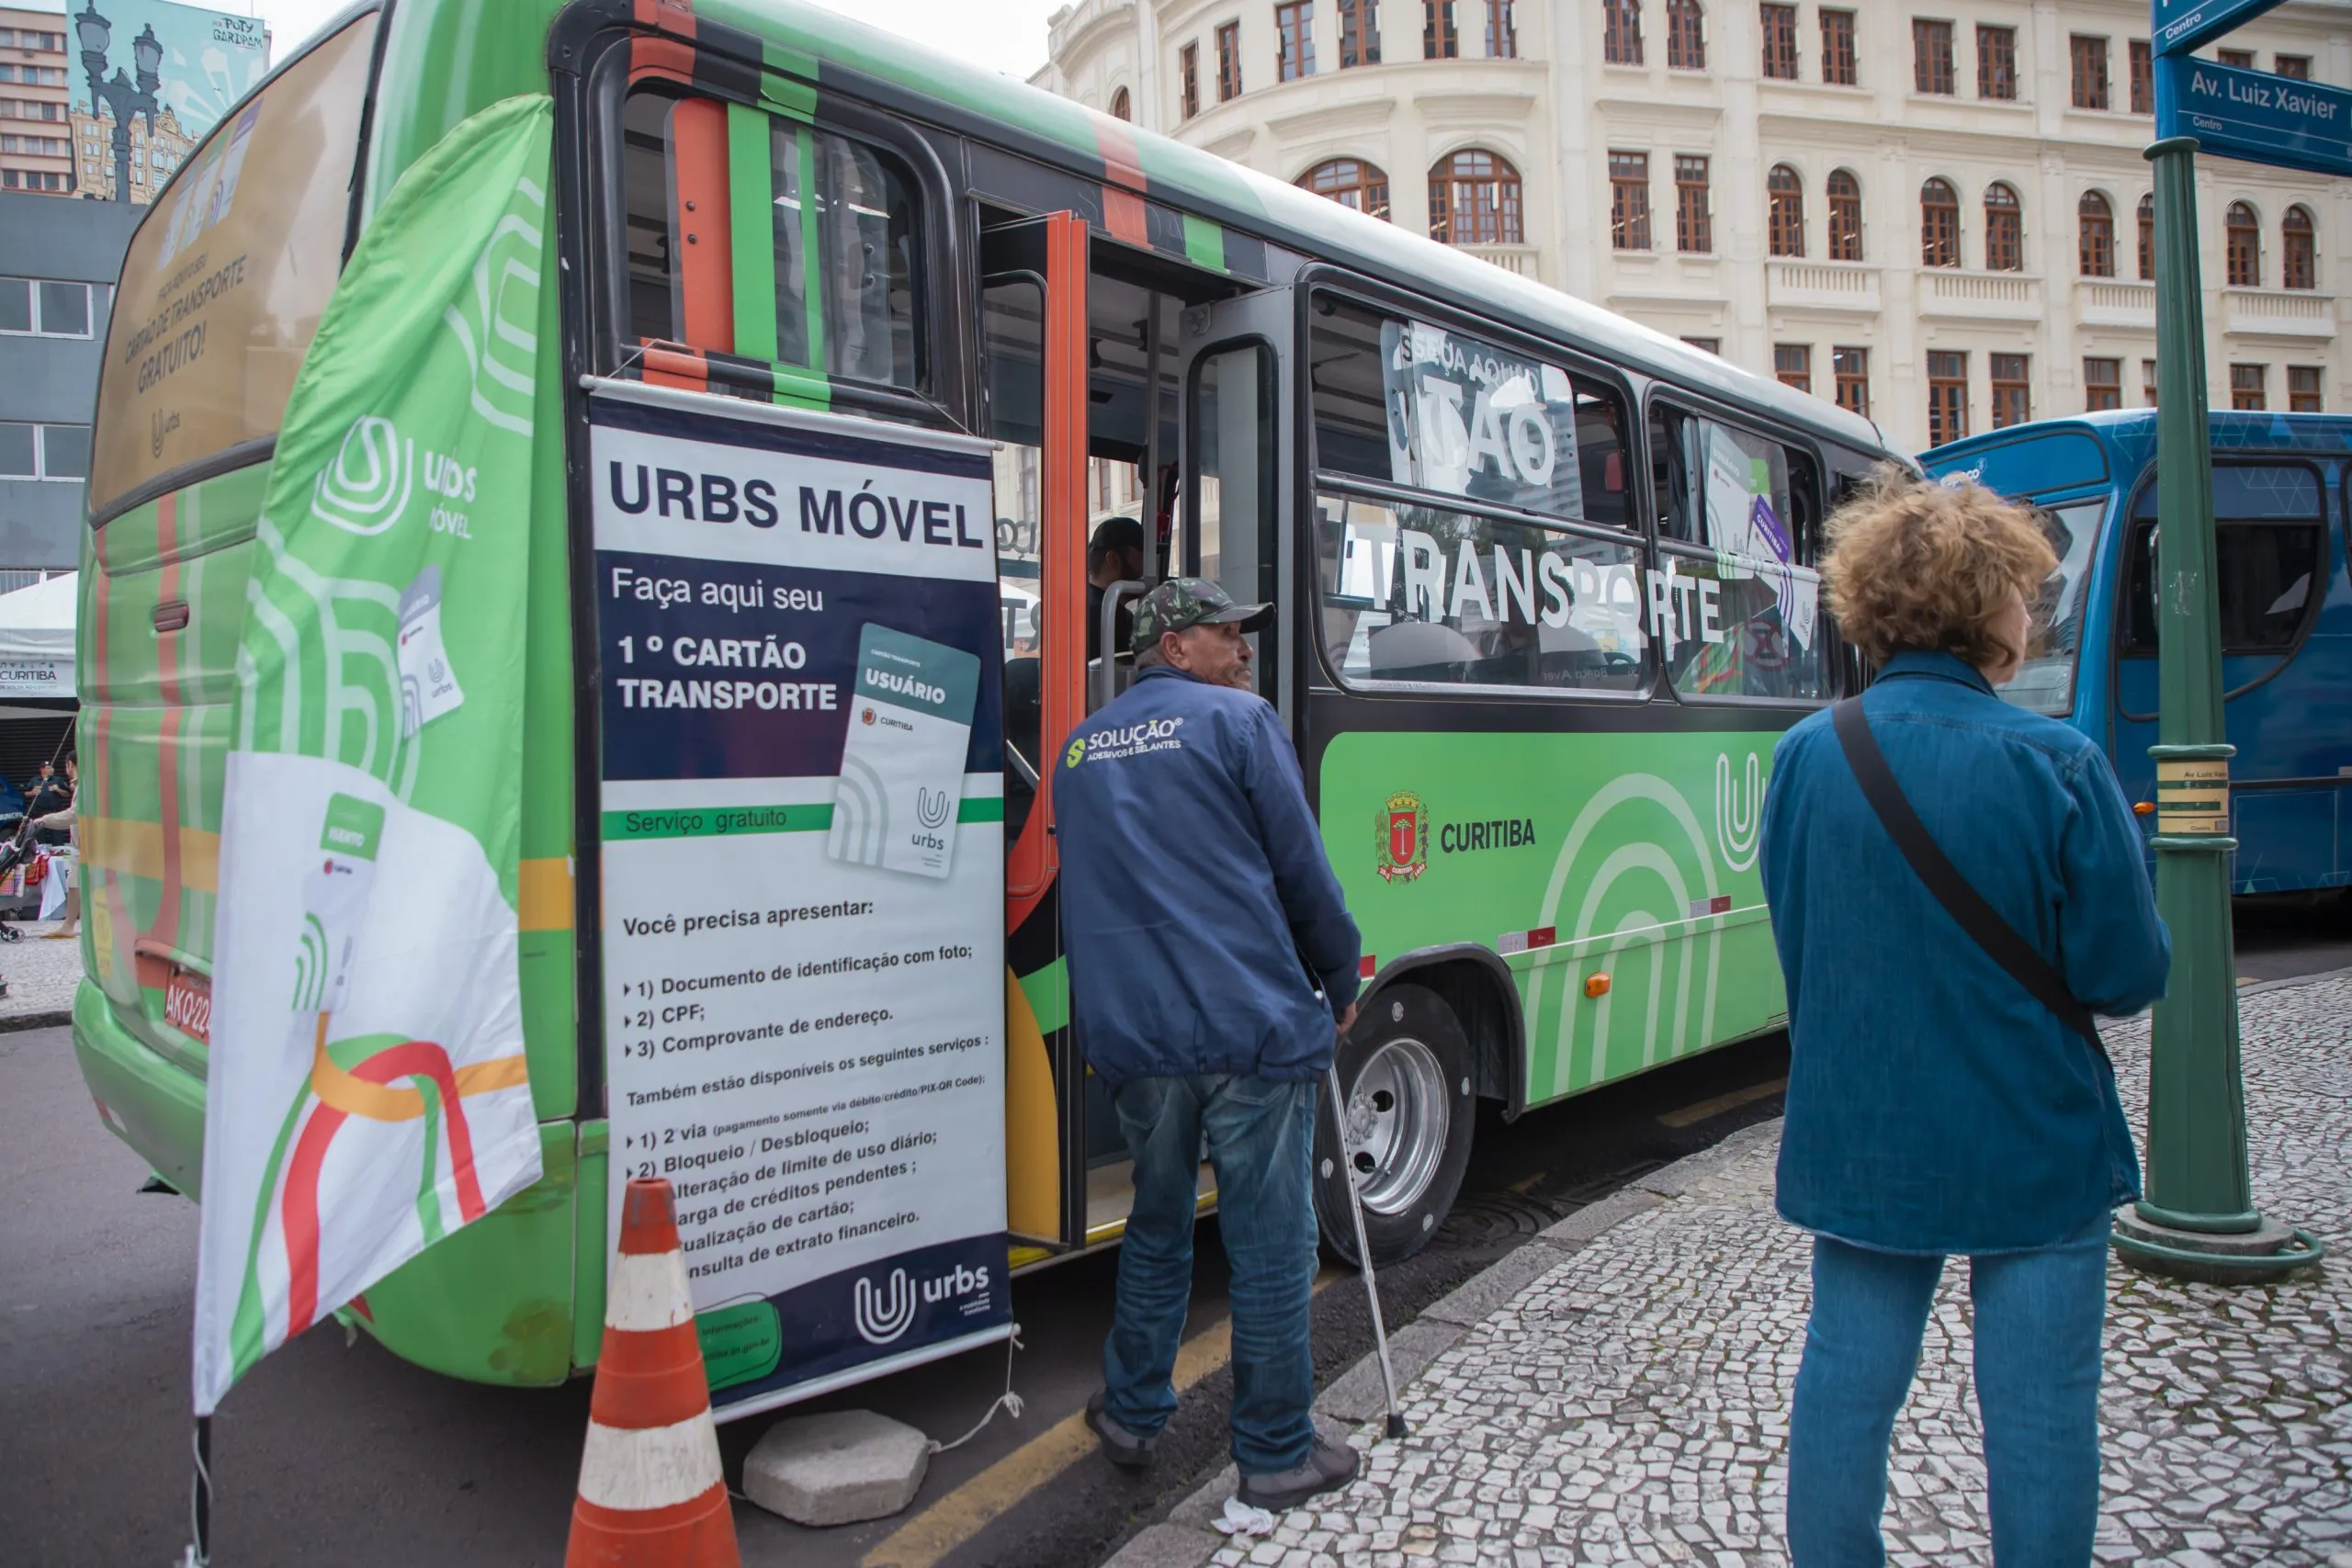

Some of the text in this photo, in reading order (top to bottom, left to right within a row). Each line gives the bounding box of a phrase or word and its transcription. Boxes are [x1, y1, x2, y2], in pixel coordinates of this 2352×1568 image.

[225, 17, 254, 33] POTY
[2165, 13, 2202, 39] Centro
[2191, 71, 2337, 120] Av. Luiz Xavier
[2193, 117, 2222, 131] Centro
[156, 306, 170, 339] DE
[170, 254, 248, 329] TRANSPORTE
[139, 320, 208, 394] GRATUITO!
[610, 460, 780, 529] URBS
[798, 479, 985, 549] MÓVEL
[612, 567, 823, 614] Faça aqui seu
[1355, 520, 1724, 643] TRANSPORTE
[673, 635, 807, 670] CARTÃO
[0, 671, 56, 681] CURITIBA
[616, 679, 837, 711] TRANSPORTE
[865, 668, 946, 705] USUÁRIO
[880, 716, 914, 732] CURITIBA
[1087, 747, 1128, 762] ADESIVOS
[1135, 740, 1182, 754] SELANTES
[626, 808, 787, 835] Serviço gratuito
[1441, 818, 1536, 853] CURITIBA
[911, 832, 944, 851] urbs
[623, 899, 874, 937] Você precisa apresentar:
[638, 943, 974, 999] 1) Documento de identificação com foto;
[638, 1004, 705, 1030] 2) CPF;
[638, 1006, 894, 1060] 3) Comprovante de endereço.
[627, 1082, 696, 1107] Também
[702, 1075, 745, 1094] estão
[750, 1058, 835, 1087] disponíveis
[839, 1057, 855, 1073] os
[859, 1043, 924, 1070] seguintes
[929, 1034, 982, 1056] serviços
[640, 1132, 657, 1151] 1)
[681, 1123, 707, 1142] via
[713, 1112, 780, 1138] (pagamento
[784, 1105, 829, 1122] somente
[831, 1101, 847, 1112] via
[639, 1161, 657, 1179] 2)
[664, 1144, 745, 1176] Bloqueio
[762, 1120, 870, 1154] Desbloqueio;
[755, 1165, 776, 1182] de
[782, 1155, 828, 1177] limite
[832, 1147, 853, 1165] de
[857, 1144, 886, 1159] uso
[890, 1131, 937, 1153] diário;
[724, 1199, 745, 1215] de
[751, 1181, 820, 1210] créditos
[825, 1162, 909, 1193] pendentes
[772, 1214, 793, 1231] de
[798, 1201, 854, 1224] cartão;
[749, 1247, 770, 1264] de
[775, 1231, 833, 1257] extrato
[838, 1213, 920, 1241] financeiro.
[923, 1264, 989, 1303] urbs
